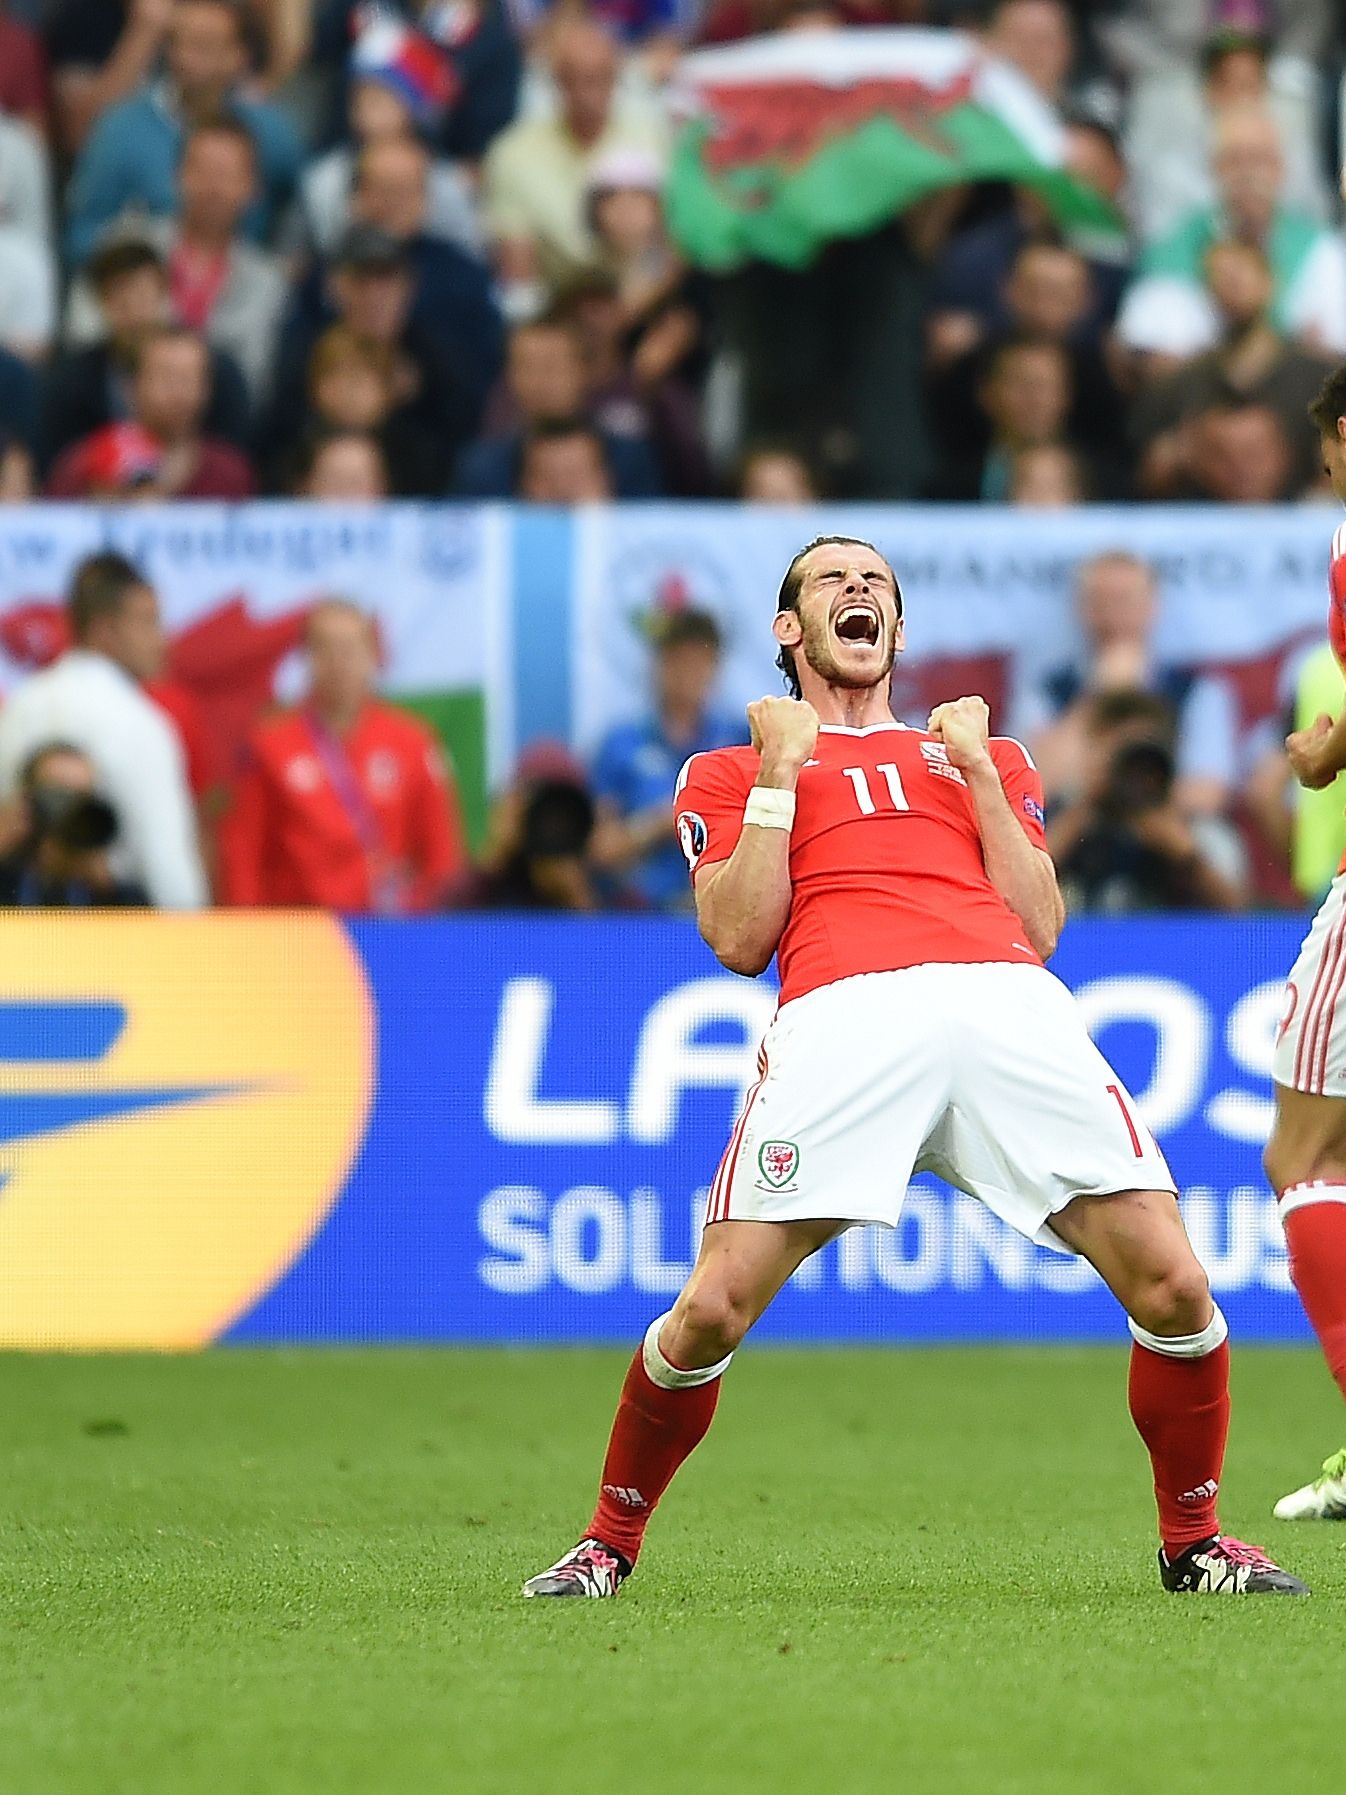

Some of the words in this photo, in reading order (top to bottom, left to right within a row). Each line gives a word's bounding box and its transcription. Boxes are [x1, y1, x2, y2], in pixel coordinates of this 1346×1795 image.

[842, 763, 910, 815] 11
[484, 975, 782, 1145] LA
[478, 1185, 1100, 1294] SOLION
